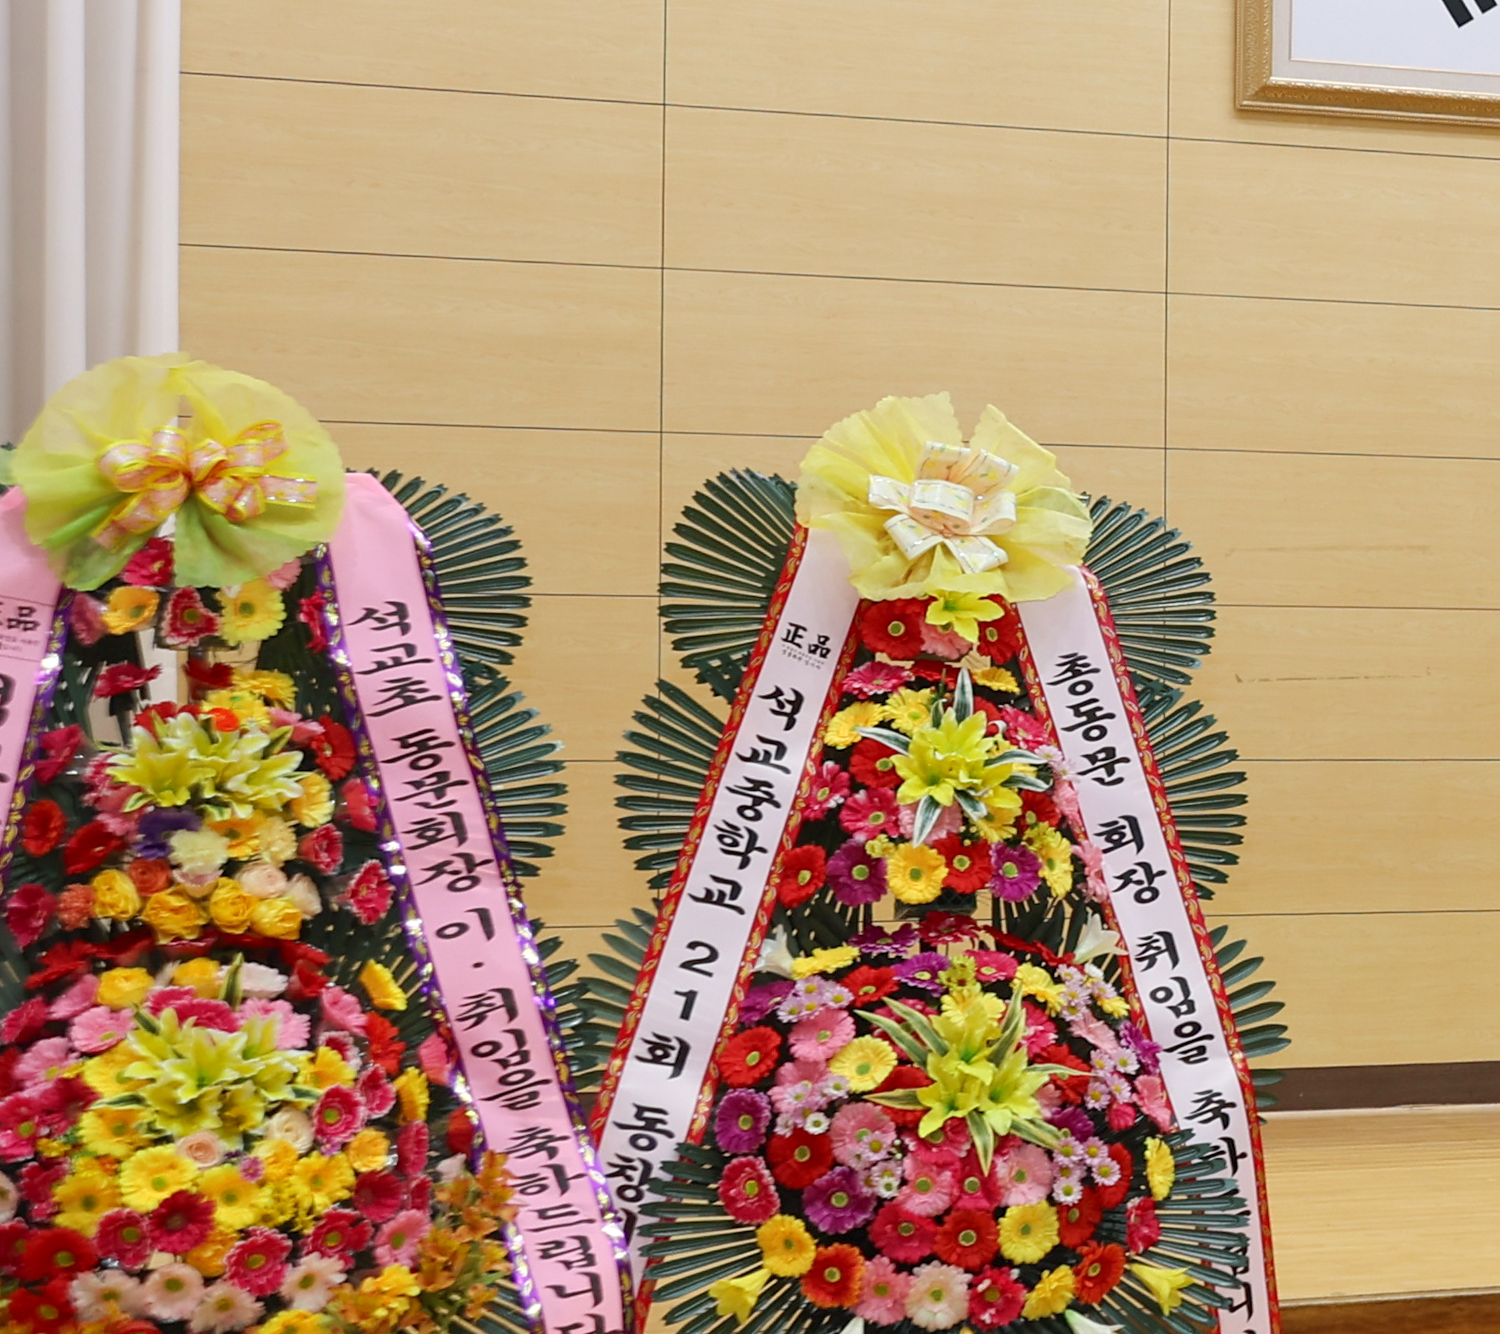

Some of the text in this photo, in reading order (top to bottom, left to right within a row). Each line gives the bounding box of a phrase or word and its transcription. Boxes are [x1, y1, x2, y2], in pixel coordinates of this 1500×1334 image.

[0, 602, 41, 633] 品
[347, 600, 443, 717] 석교초
[780, 622, 832, 660] 正品
[380, 728, 497, 893] 동문회장
[688, 684, 804, 916] 석교중학교
[1093, 814, 1167, 905] 회장
[1134, 930, 1216, 1064] 취임을
[635, 940, 720, 1080] 21회
